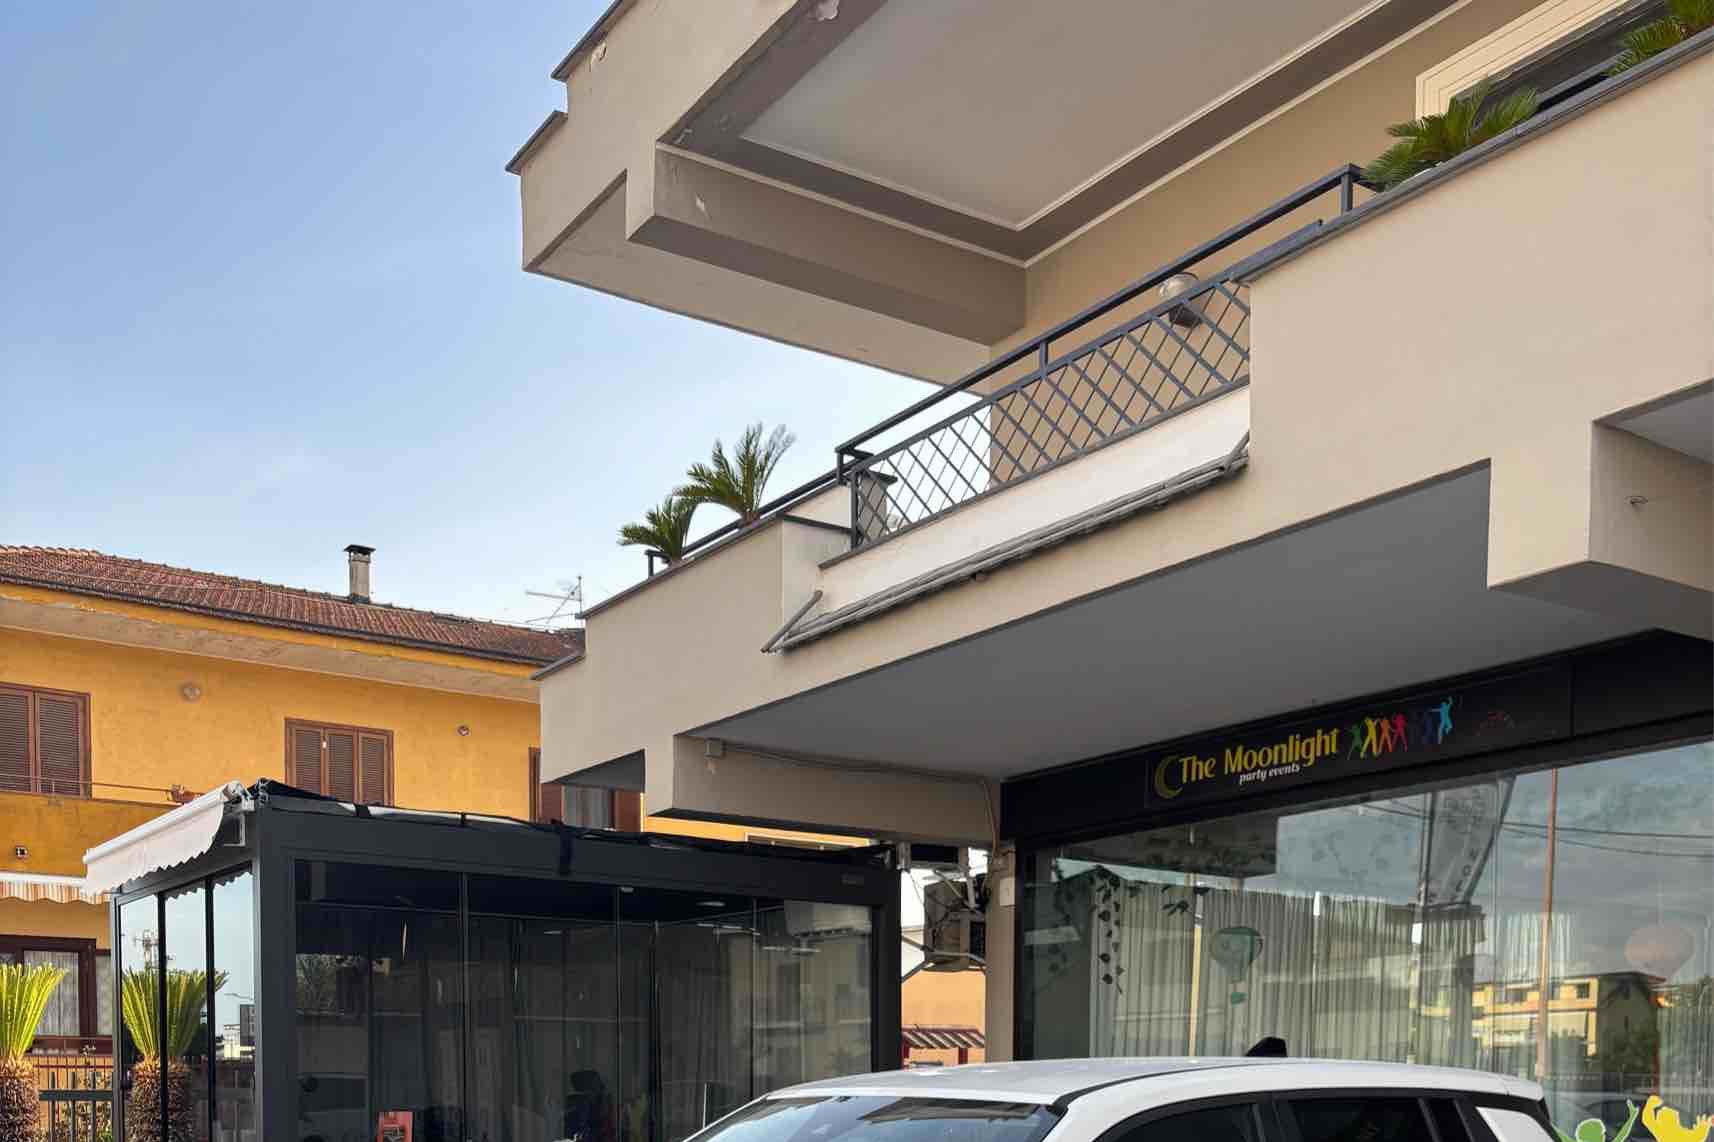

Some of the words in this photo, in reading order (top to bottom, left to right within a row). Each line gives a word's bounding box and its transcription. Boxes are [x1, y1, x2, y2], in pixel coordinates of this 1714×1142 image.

[1178, 754, 1217, 785] The
[1223, 727, 1339, 775] Moonlight
[1239, 769, 1267, 786] party
[1268, 763, 1301, 777] events
